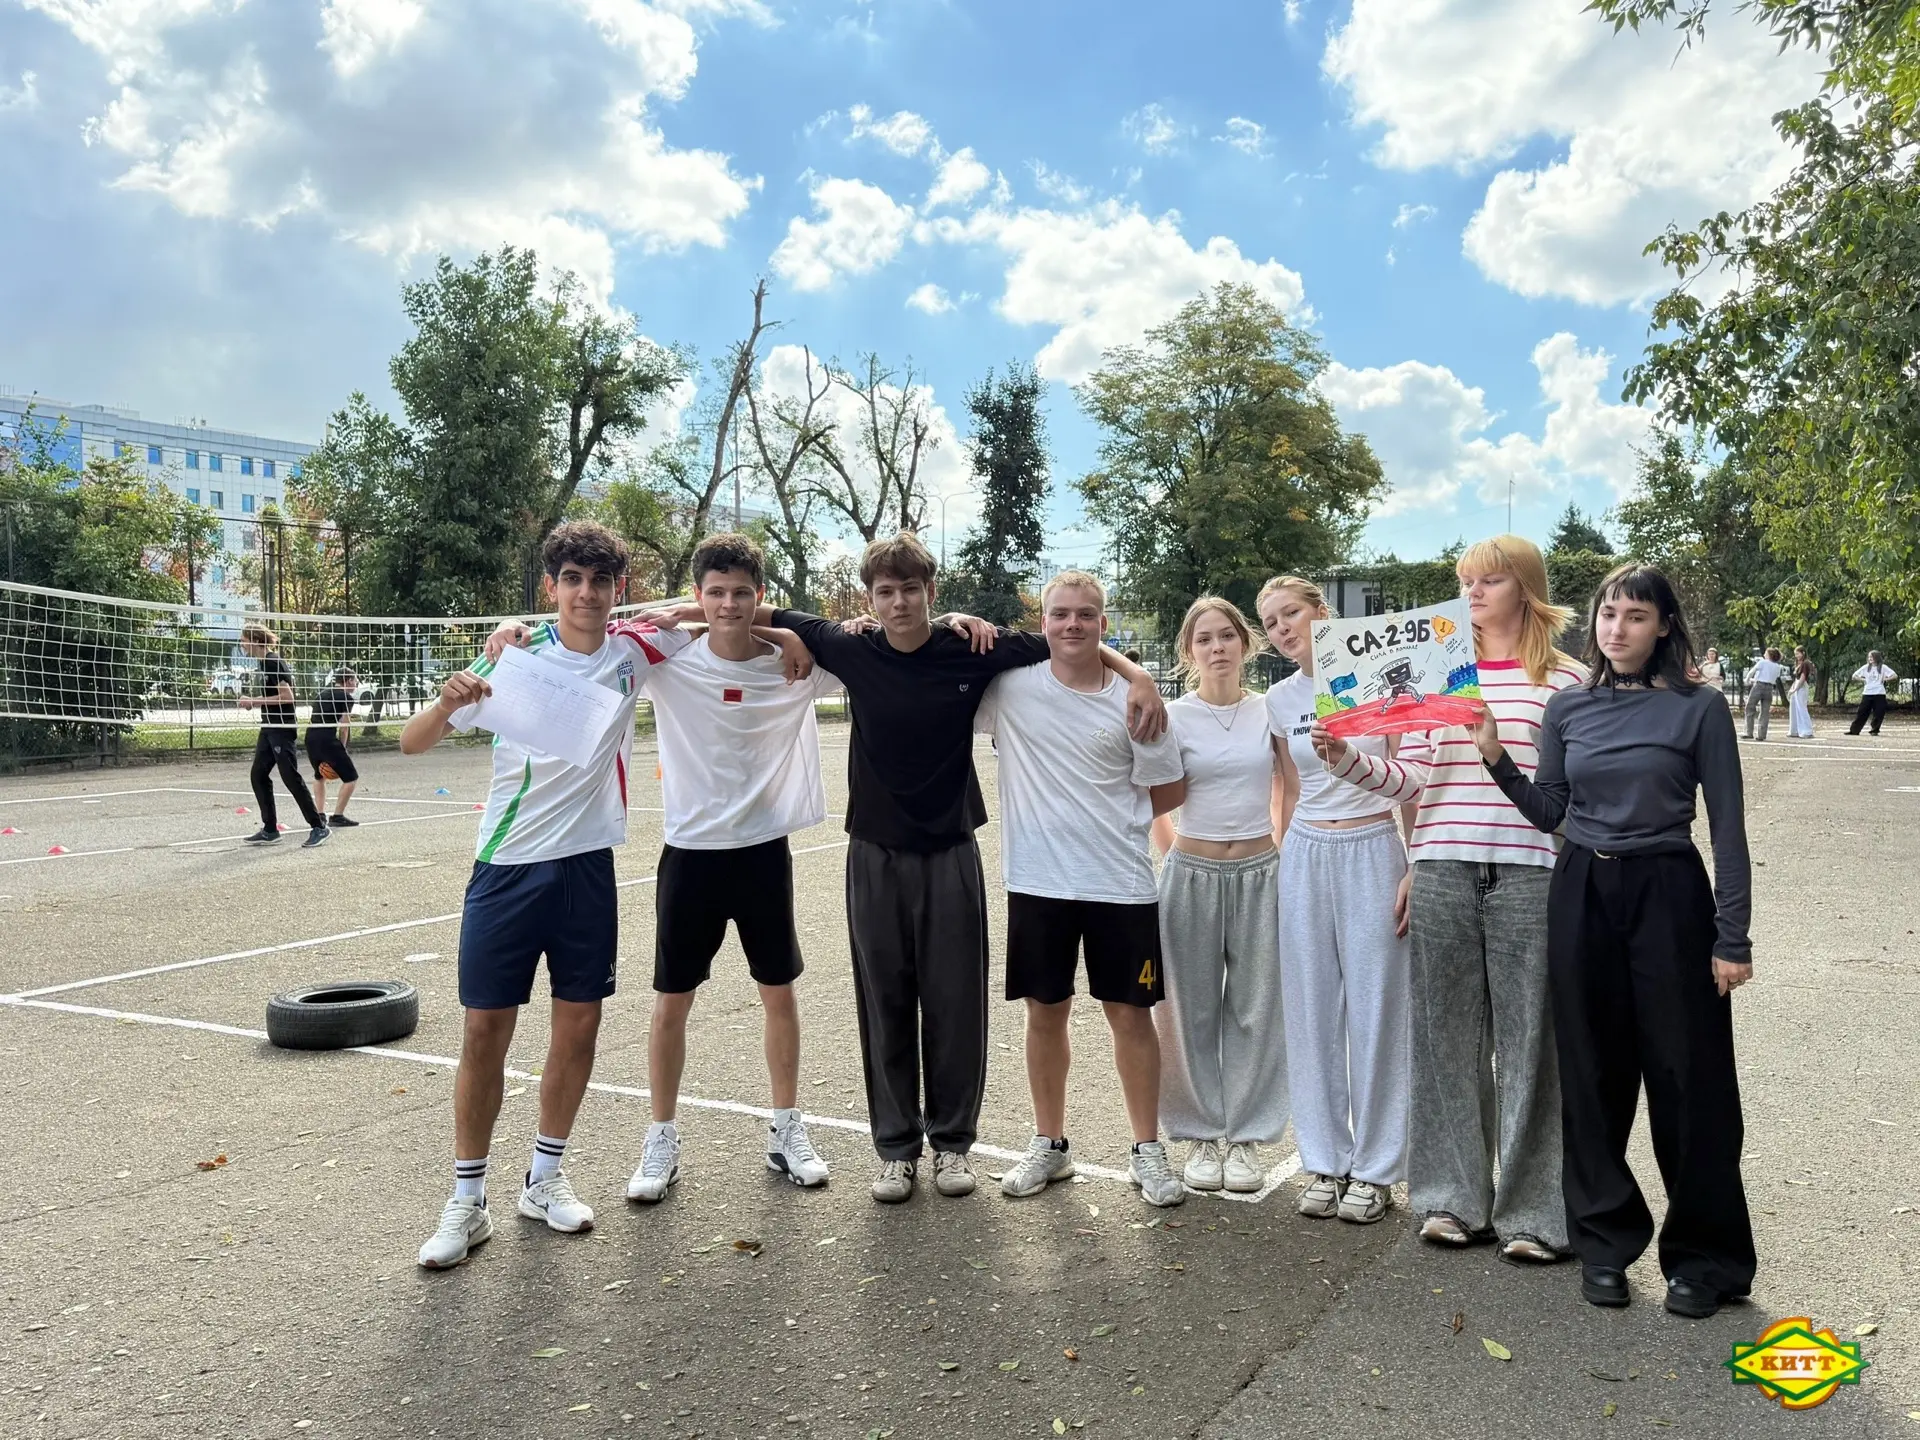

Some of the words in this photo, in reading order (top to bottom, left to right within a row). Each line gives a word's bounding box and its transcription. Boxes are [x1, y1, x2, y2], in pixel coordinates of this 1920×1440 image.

[1440, 621, 1446, 633] 1
[620, 667, 633, 676] ITALIA
[1300, 714, 1310, 723] MY
